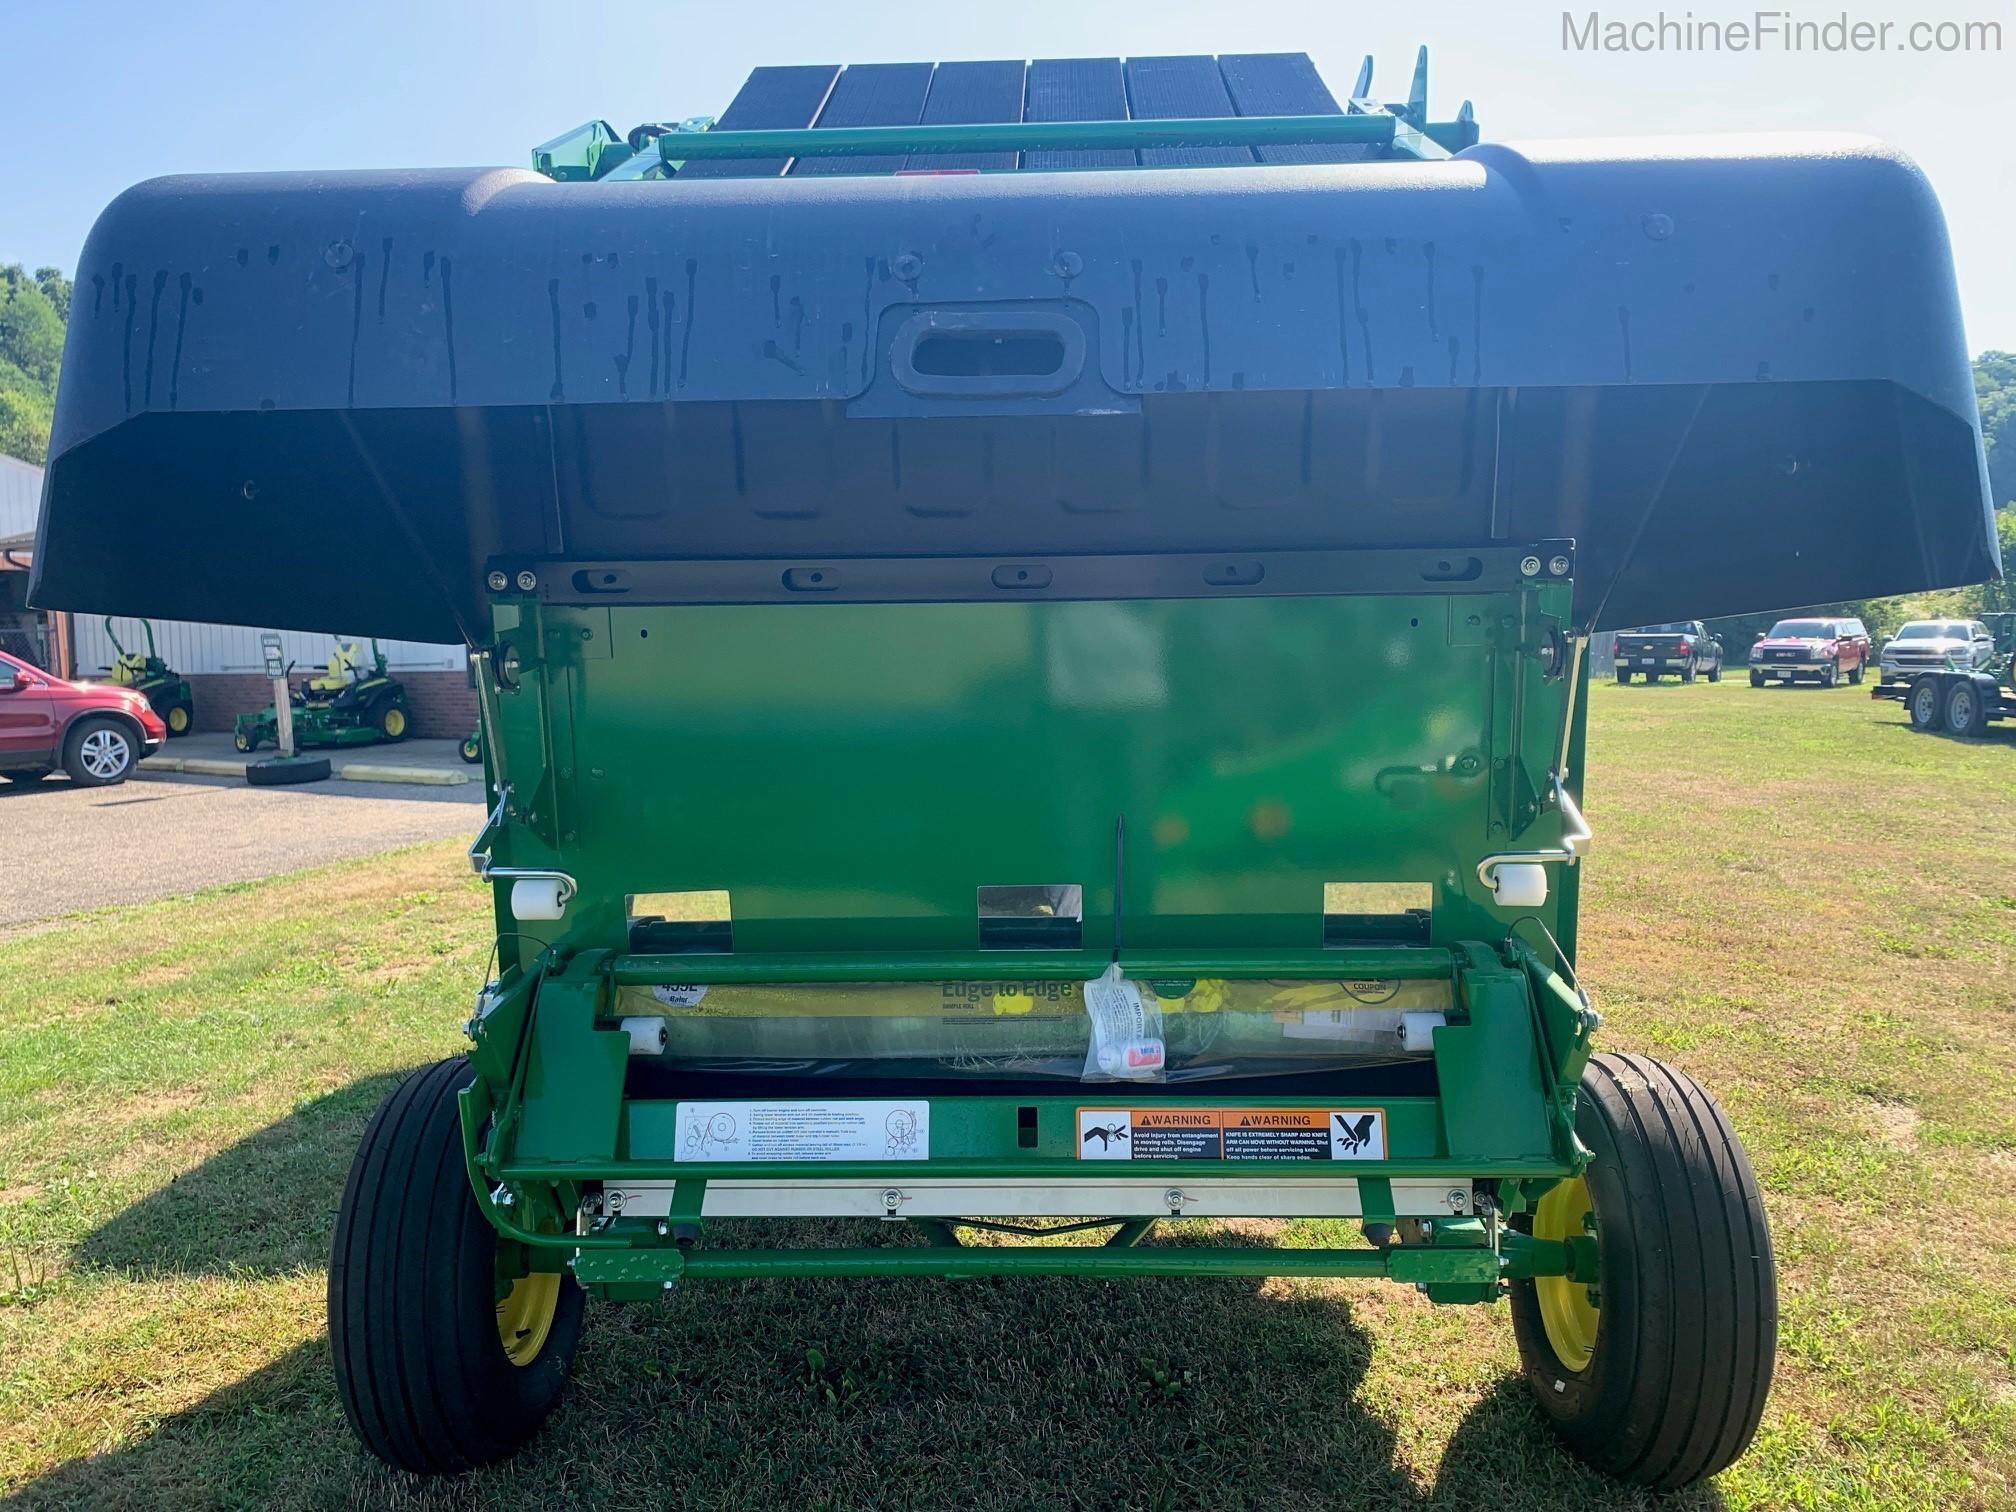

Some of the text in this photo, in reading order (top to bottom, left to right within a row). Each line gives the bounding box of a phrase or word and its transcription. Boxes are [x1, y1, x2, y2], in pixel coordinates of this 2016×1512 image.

[942, 980, 1072, 1002] Edge to Edge
[669, 995, 688, 1003] Baler
[1132, 1001, 1144, 1040] IMPORTA
[1152, 1115, 1211, 1125] WARNING
[1251, 1115, 1311, 1126] WARNING
